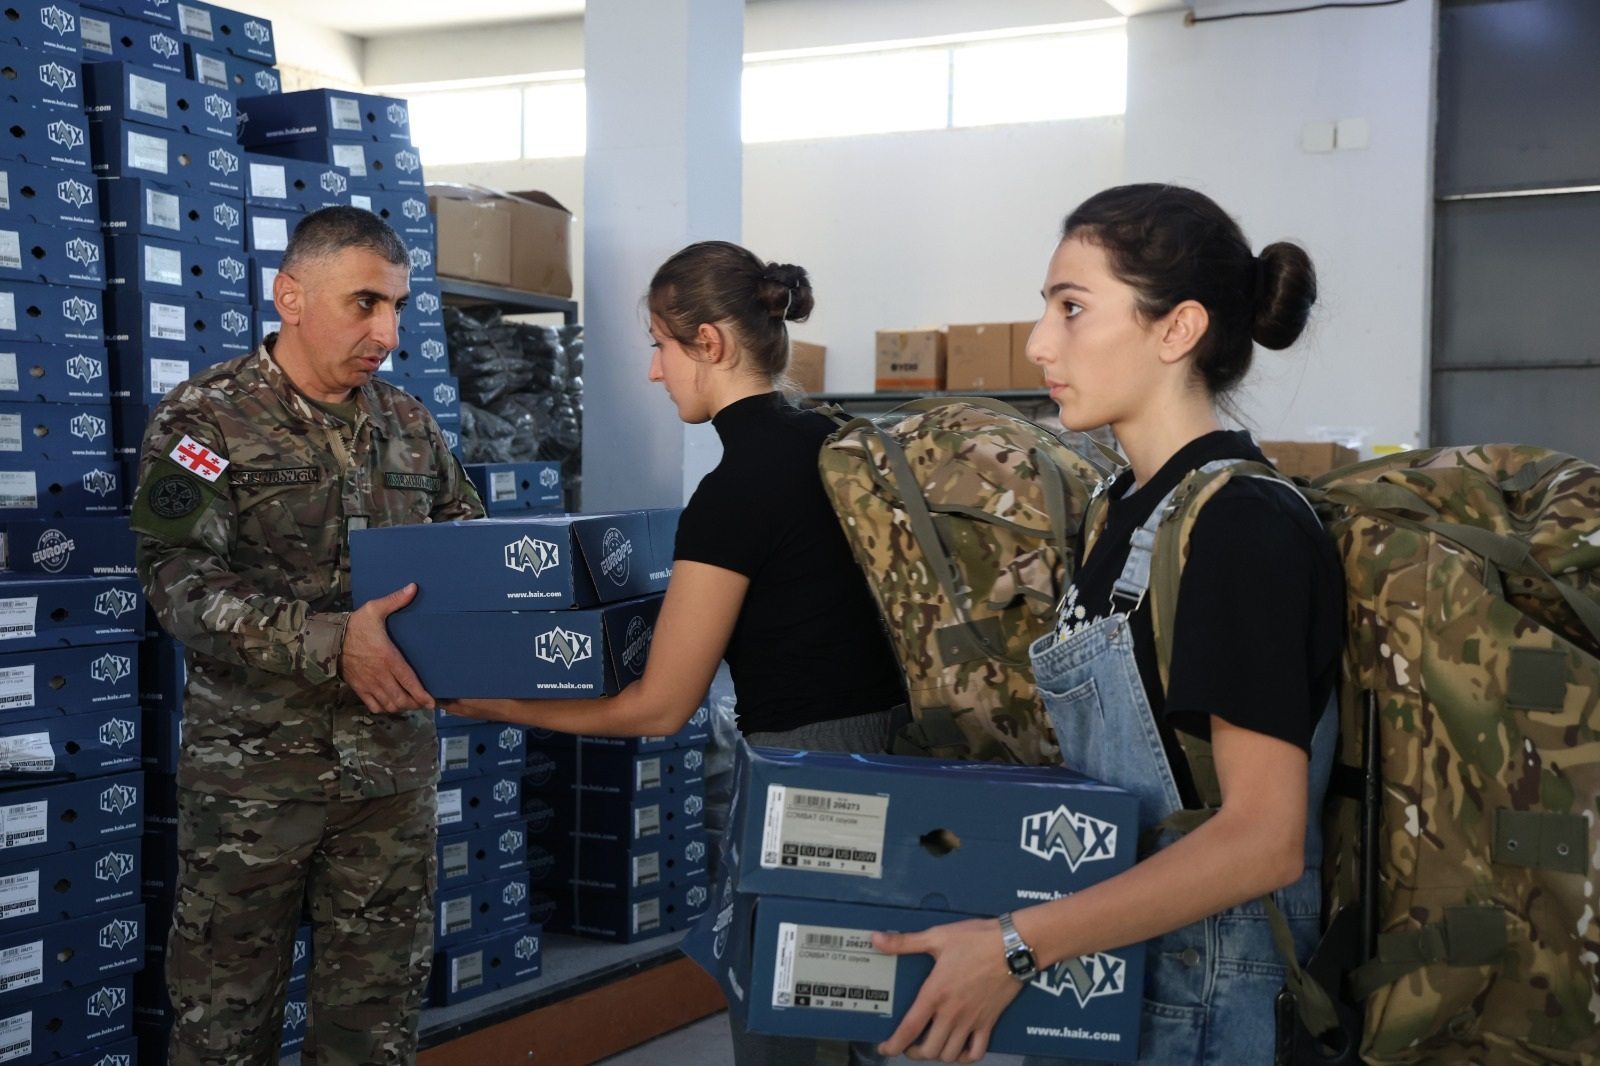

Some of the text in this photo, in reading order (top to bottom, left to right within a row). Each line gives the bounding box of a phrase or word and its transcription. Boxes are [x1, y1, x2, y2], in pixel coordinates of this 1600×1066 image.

[32, 539, 75, 564] EUROPE
[601, 539, 632, 576] EUROPE
[93, 565, 137, 573] www.haix.c
[507, 591, 562, 599] www.haix.com
[1027, 1026, 1120, 1041] www.haix.com
